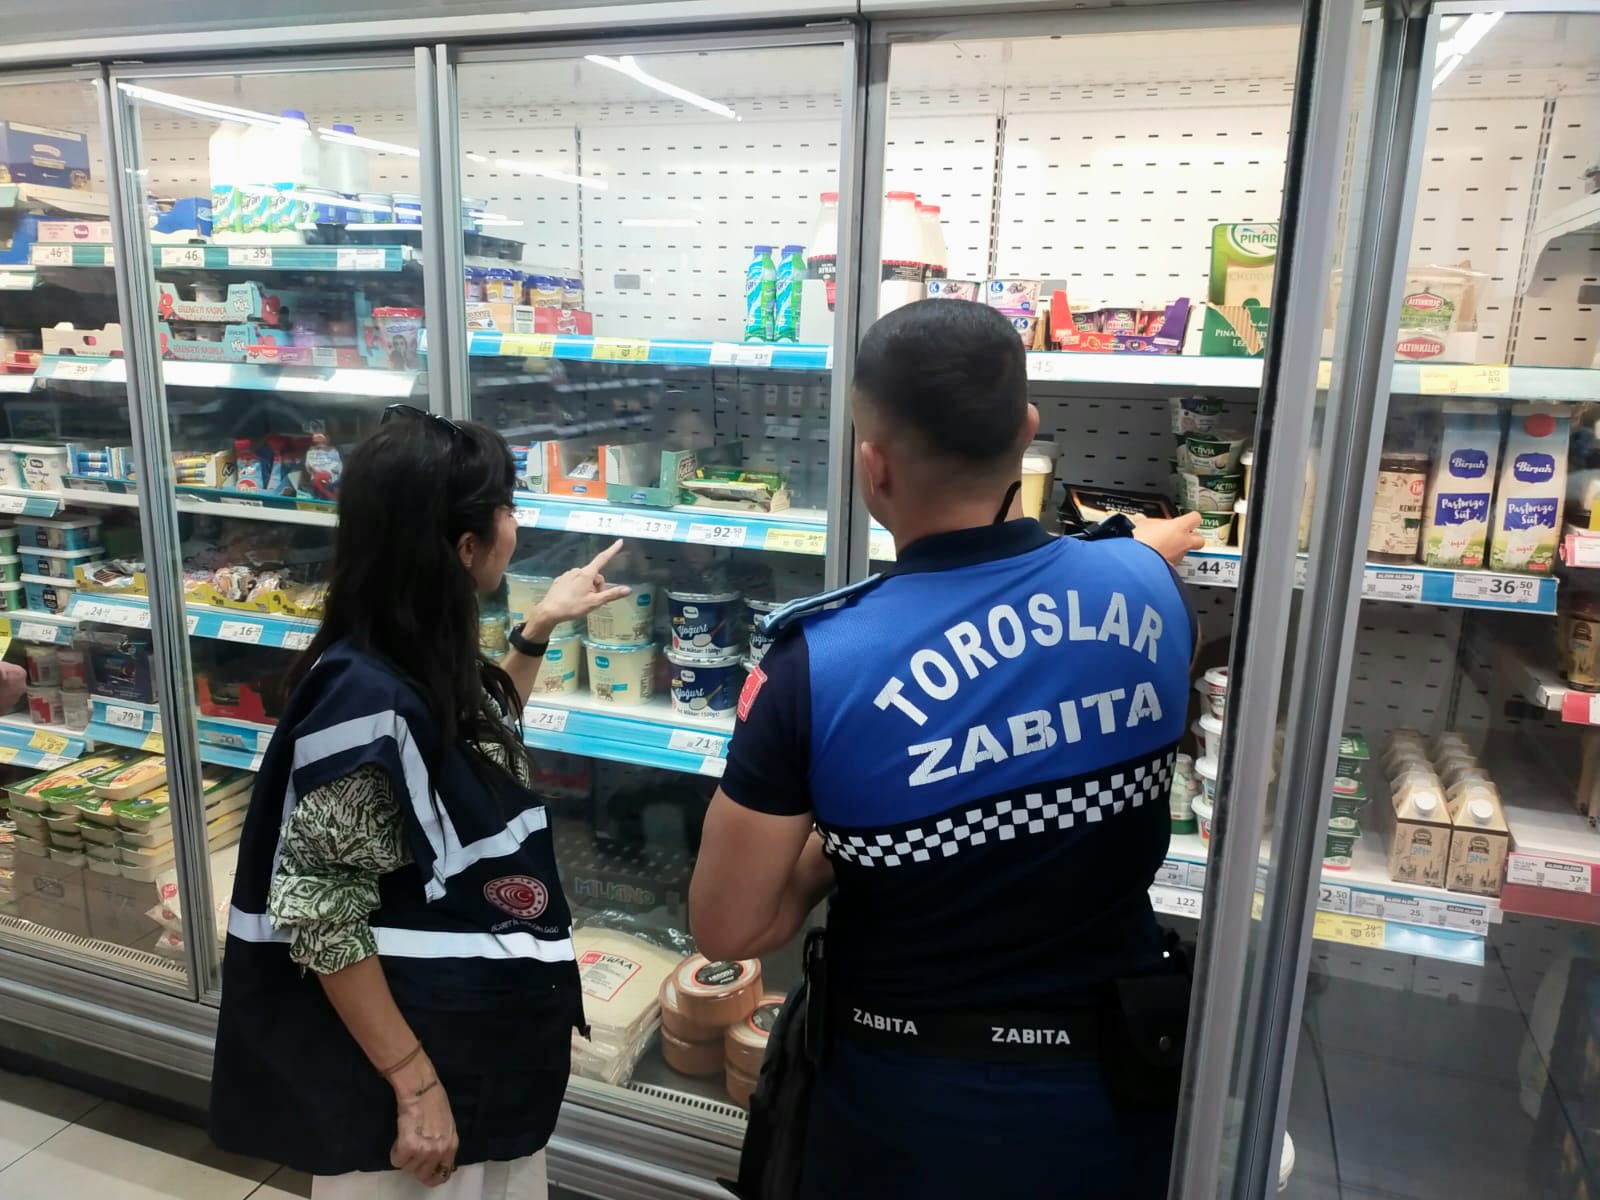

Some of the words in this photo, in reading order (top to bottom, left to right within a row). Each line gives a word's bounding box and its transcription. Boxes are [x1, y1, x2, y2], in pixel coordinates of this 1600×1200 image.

[184, 250, 198, 261] 46
[253, 248, 266, 258] 39
[1521, 513, 1539, 525] Süt
[239, 626, 251, 636] 16
[873, 589, 1164, 727] TOROSLAR
[121, 711, 134, 721] 79
[908, 681, 1163, 787] ZABITA
[1569, 875, 1582, 884] 37
[1176, 896, 1196, 907] 122
[852, 1007, 919, 1036] ZABITA
[991, 1026, 1071, 1046] ZABITA
